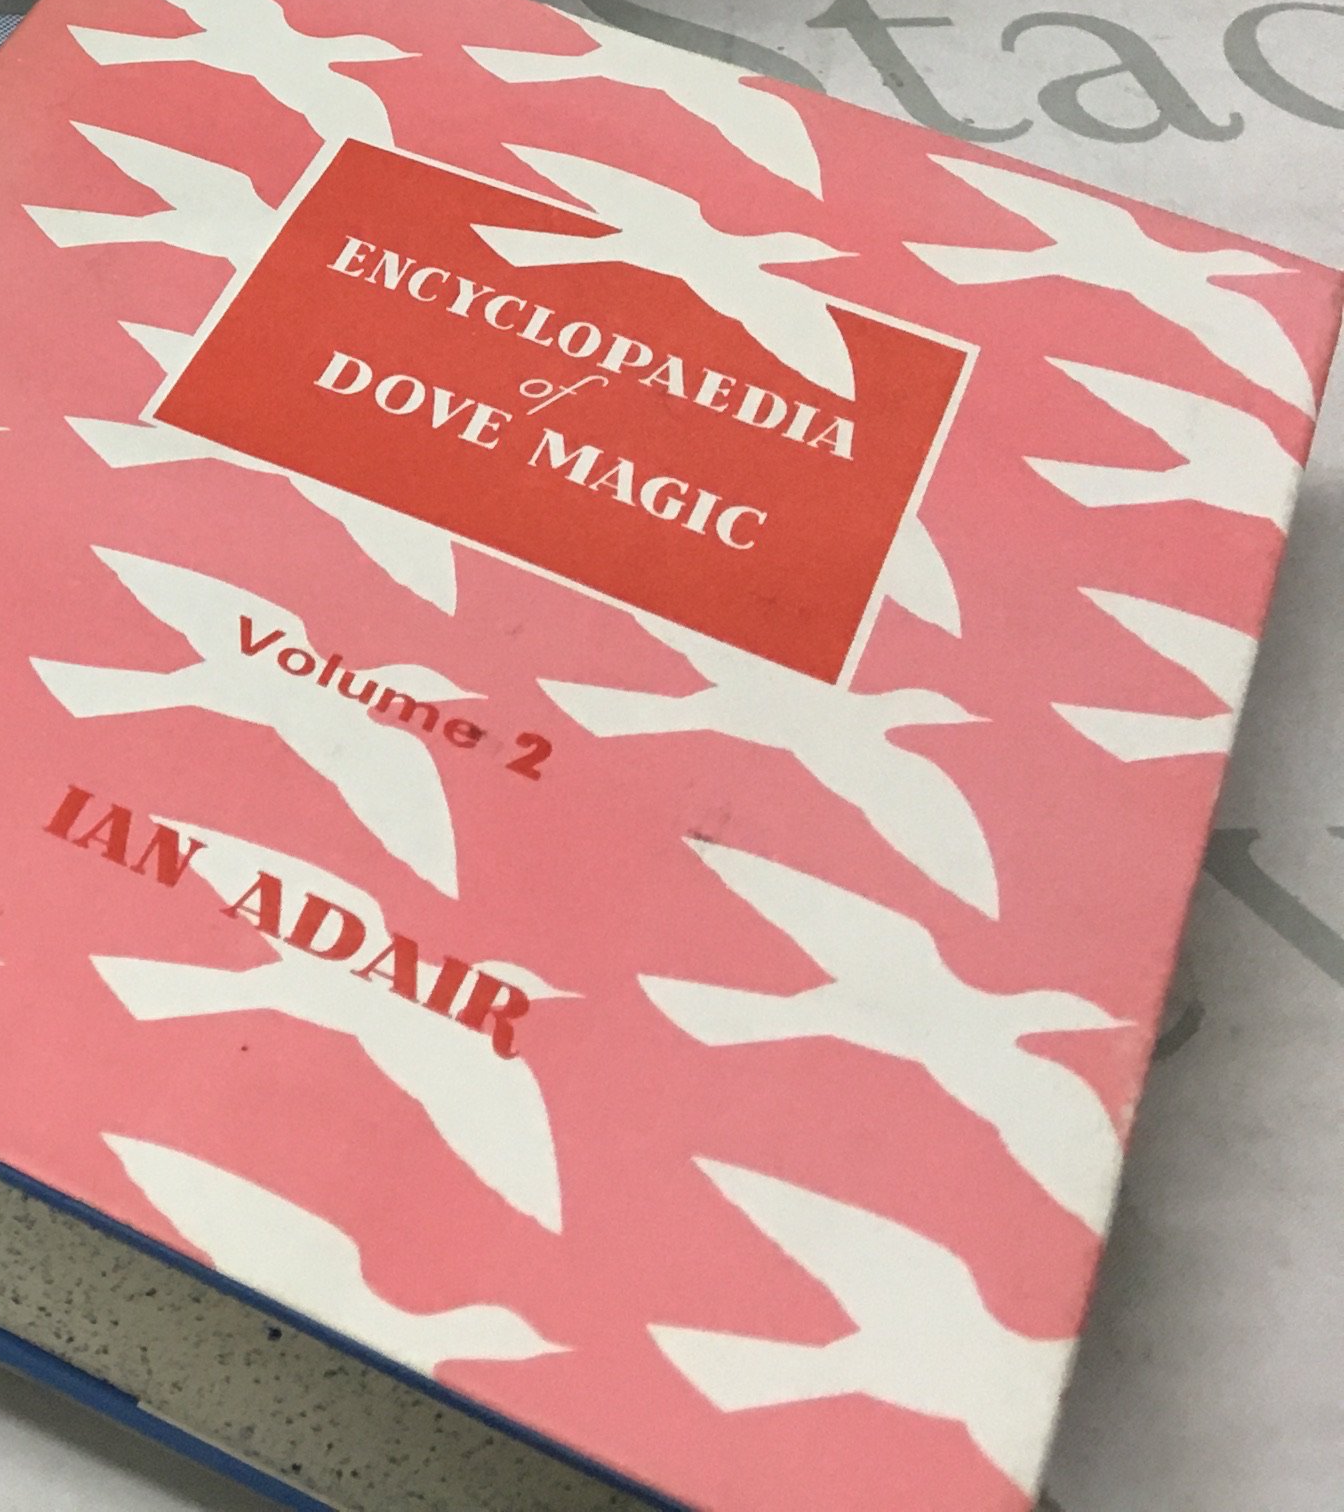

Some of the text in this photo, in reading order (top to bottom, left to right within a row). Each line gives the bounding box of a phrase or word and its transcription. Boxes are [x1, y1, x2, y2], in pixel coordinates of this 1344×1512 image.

[326, 235, 858, 460] ENCYCLOPAEDIA
[519, 373, 609, 418] of
[314, 350, 769, 552] DOVE MAGIC
[237, 614, 555, 781] Volume 2
[42, 784, 531, 1060] IAN ADAIR
